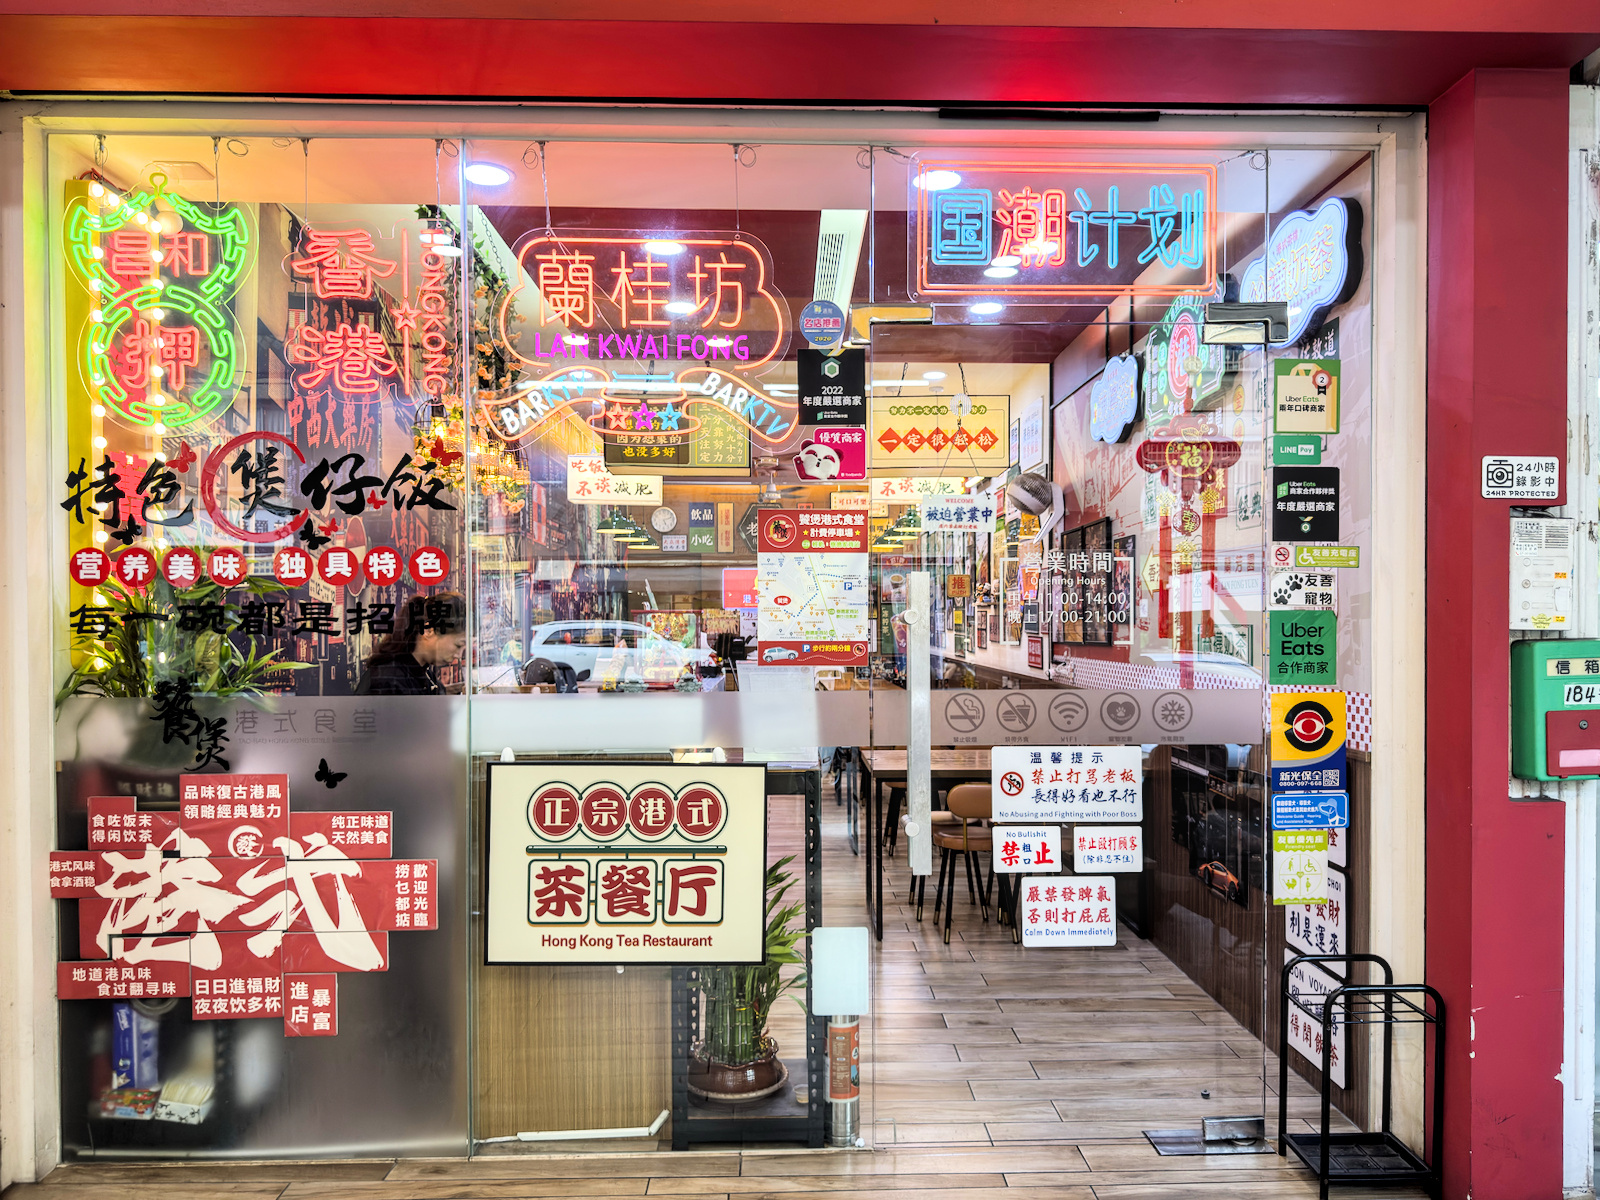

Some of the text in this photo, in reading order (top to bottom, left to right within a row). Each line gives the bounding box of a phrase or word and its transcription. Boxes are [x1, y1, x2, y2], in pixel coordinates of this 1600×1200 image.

[930, 185, 1205, 268] 国潮计划
[111, 231, 210, 277] 昌和
[535, 250, 746, 328] 蘭桂坊
[291, 228, 398, 393] 香港
[534, 332, 750, 361] LAN KWAI FONG
[121, 319, 200, 391] 押
[1319, 376, 1325, 384] 2
[821, 386, 844, 395] 2022
[819, 432, 862, 443] 優質商家
[881, 432, 994, 446] 一定很轻松
[1280, 446, 1313, 455] LINE Pay
[1516, 463, 1556, 473] 24小時
[60, 446, 458, 526] 特色煲仔饭
[1516, 476, 1555, 487] 錄影中
[690, 534, 714, 546] 小吃
[75, 551, 443, 585] 营养美味 独具特色
[1023, 551, 1112, 573] 營業時間
[951, 576, 966, 590] 推
[1031, 576, 1106, 588] Opening Hours
[1304, 574, 1333, 588] 友善
[69, 599, 458, 640] 每一碗都是招牌
[1281, 622, 1324, 638] Uber
[1281, 641, 1324, 656] Eats
[1277, 662, 1329, 674] 合作商家
[1555, 659, 1600, 675] 信箱
[234, 708, 377, 734] 港式食堂
[1030, 752, 1104, 764] 温馨提示
[1280, 771, 1322, 781] 新光保全
[184, 784, 282, 800] 品味復古港風
[184, 804, 282, 819] 領略經典魅力
[542, 797, 714, 827] 正宗港式
[1010, 811, 1039, 819] Abusing
[1054, 811, 1084, 819] Fighting
[331, 815, 389, 829] 纯正味道
[92, 829, 152, 842] 得闲饮茶
[331, 831, 388, 845] 天然美食
[1001, 841, 1020, 867] 禁
[1034, 841, 1054, 865] 止
[49, 861, 95, 872] 港式风味
[413, 864, 429, 927] 歡迎光臨
[534, 865, 718, 918] 茶餐厅
[1027, 908, 1111, 924] 否則打屁屁
[1024, 928, 1043, 936] Calm
[1067, 927, 1114, 936] Immediately
[541, 934, 713, 949] Hong Kong Tea Restaurant
[72, 967, 152, 982] 地道港风味
[97, 982, 177, 997] 食过翻寻味
[195, 977, 281, 995] 日日進福財
[195, 996, 282, 1015] 夜夜饮多杯
[290, 981, 309, 1024] 進店
[312, 988, 331, 1031] 暴富
